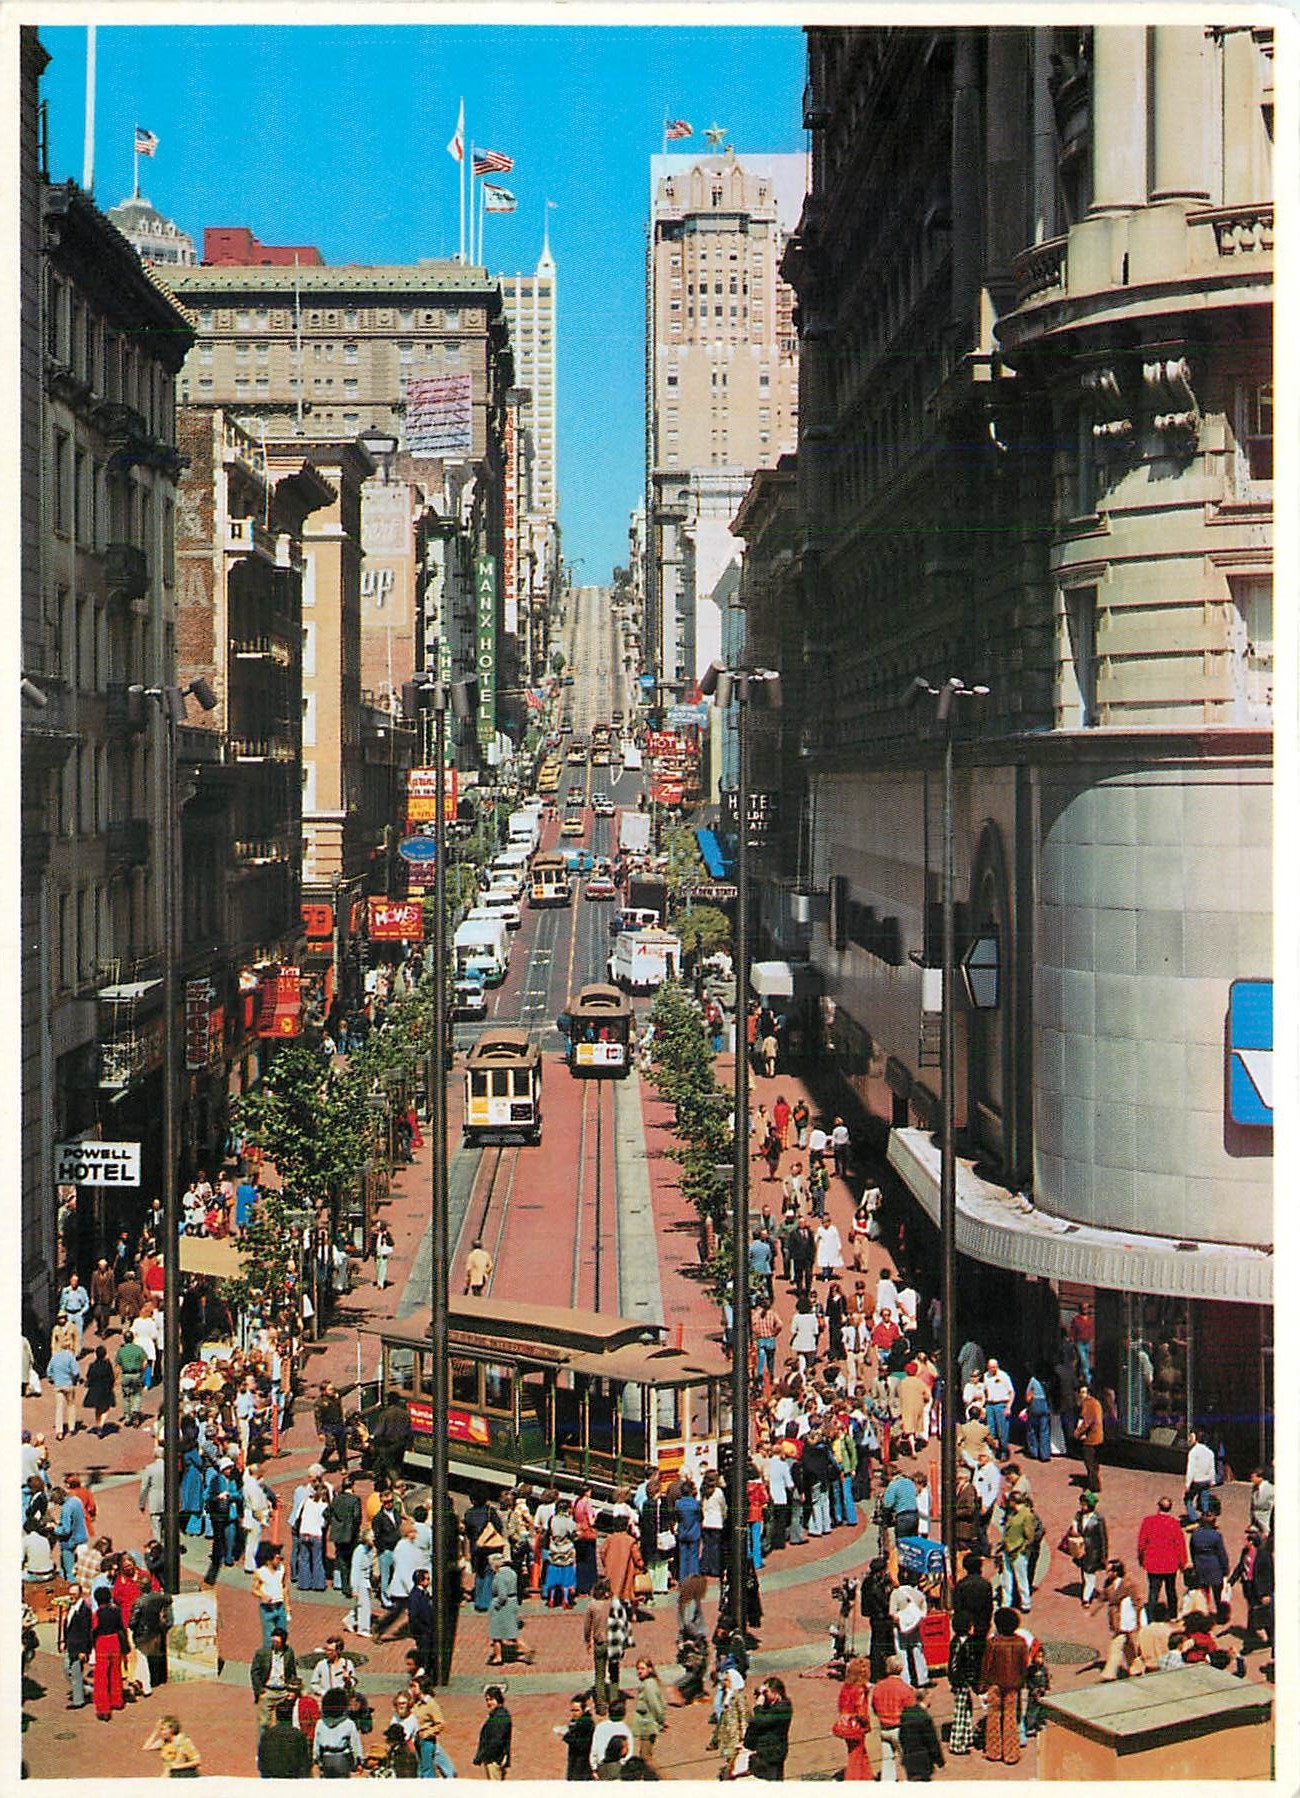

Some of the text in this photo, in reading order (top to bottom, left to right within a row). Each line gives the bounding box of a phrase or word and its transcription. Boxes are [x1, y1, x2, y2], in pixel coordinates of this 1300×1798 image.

[479, 562, 493, 627] MANX
[480, 637, 493, 719] HOTEL
[728, 794, 777, 809] HTEL
[63, 1148, 132, 1160] POWELL
[58, 1162, 135, 1181] HOTEL
